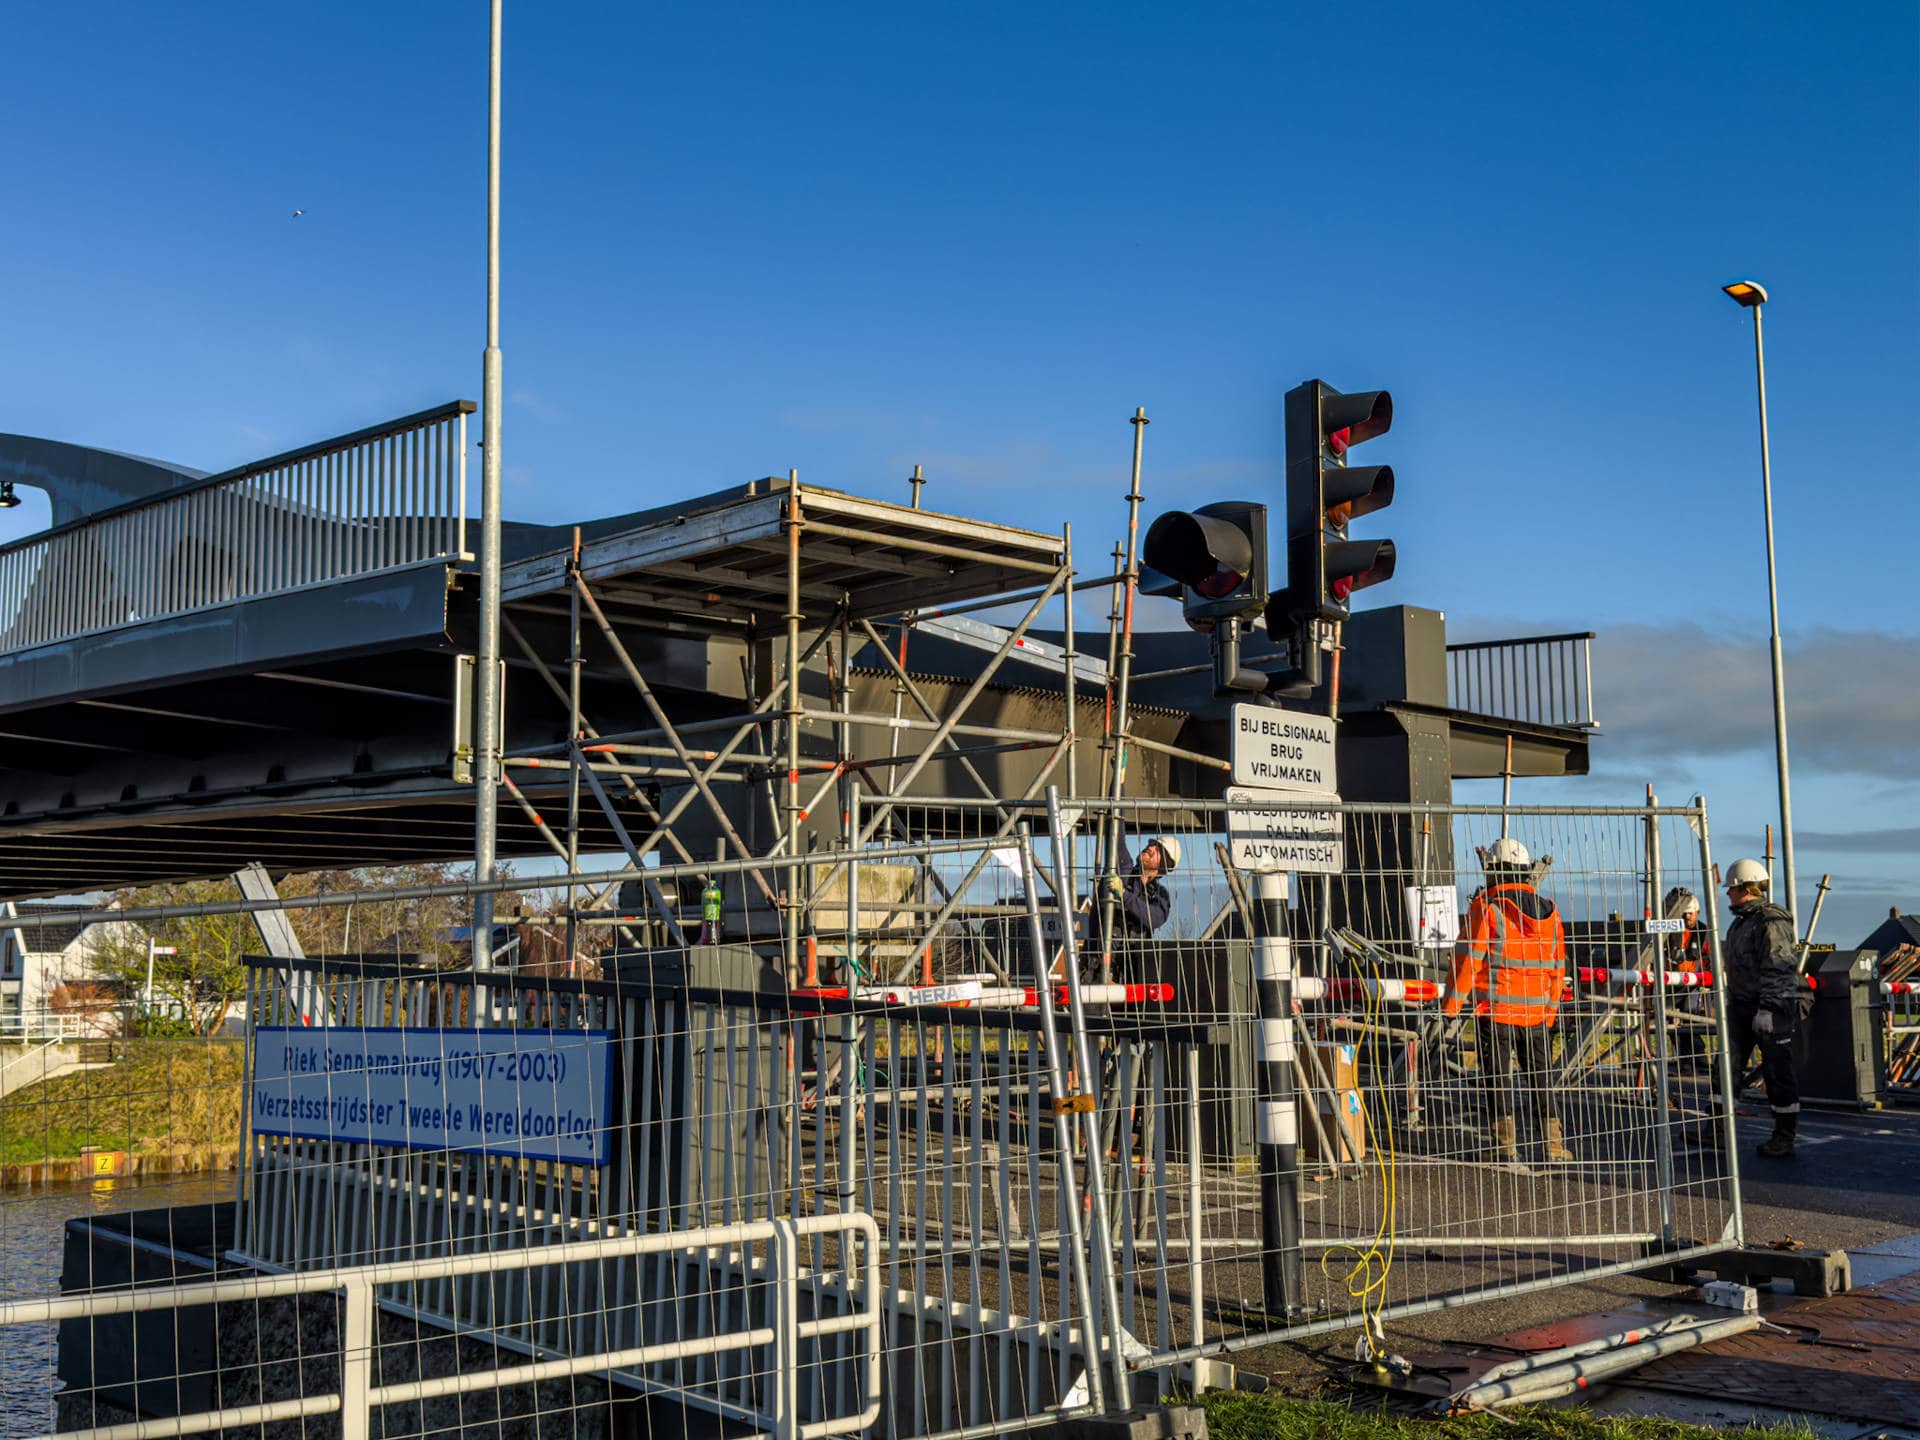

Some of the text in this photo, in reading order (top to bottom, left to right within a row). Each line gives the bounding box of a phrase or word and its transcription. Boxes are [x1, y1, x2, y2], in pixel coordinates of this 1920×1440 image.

[1240, 718, 1331, 744] BIJ BELSIGNAAL
[1270, 744, 1303, 760] BRUG
[1251, 762, 1321, 784] VRIJMAKEN
[1266, 825, 1309, 841] DALEN
[1243, 845, 1333, 862] AUTOMATISCH
[908, 985, 965, 1004] HERA
[283, 1046, 567, 1086] Riek Sennemabrug (1907-2003)
[258, 1091, 596, 1150] Verzetsstrijdster Tweede Wereldoorlog
[100, 1158, 108, 1170] Z
